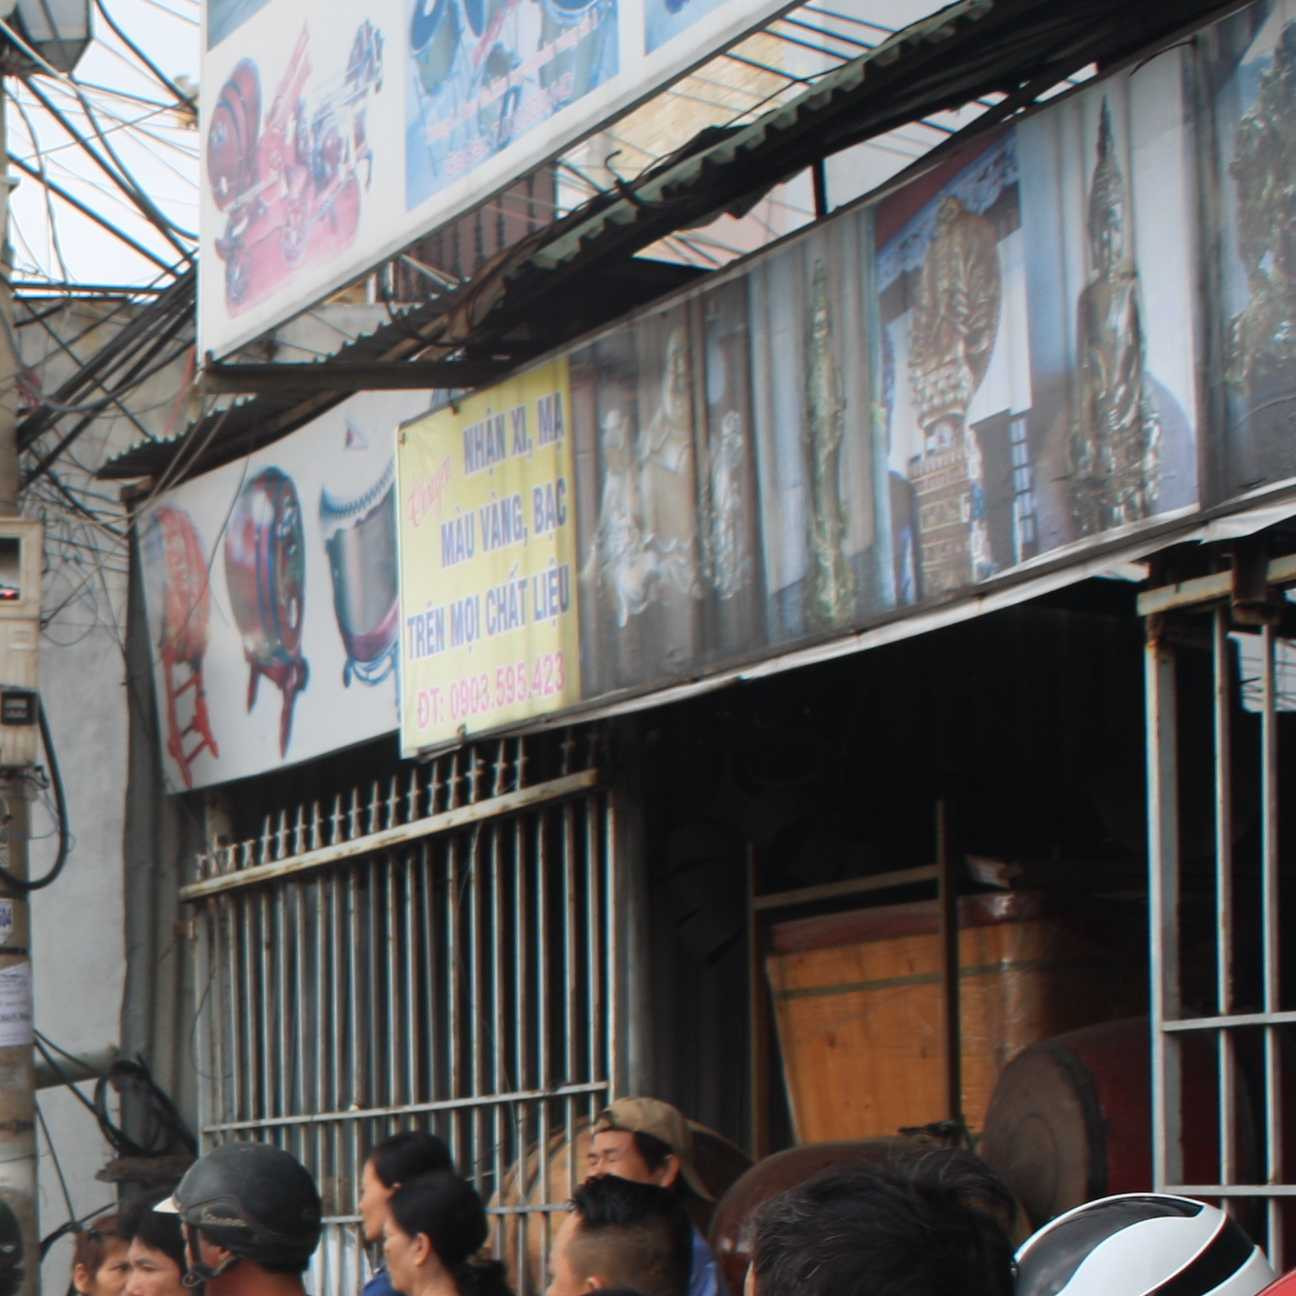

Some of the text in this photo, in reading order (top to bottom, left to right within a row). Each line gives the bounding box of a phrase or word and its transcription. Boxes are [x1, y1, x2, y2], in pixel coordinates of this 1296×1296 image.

[441, 506, 475, 568] MÀU
[533, 477, 567, 540] BẠC
[407, 557, 570, 659] TRÊN MỌI CHẤT LIỆU
